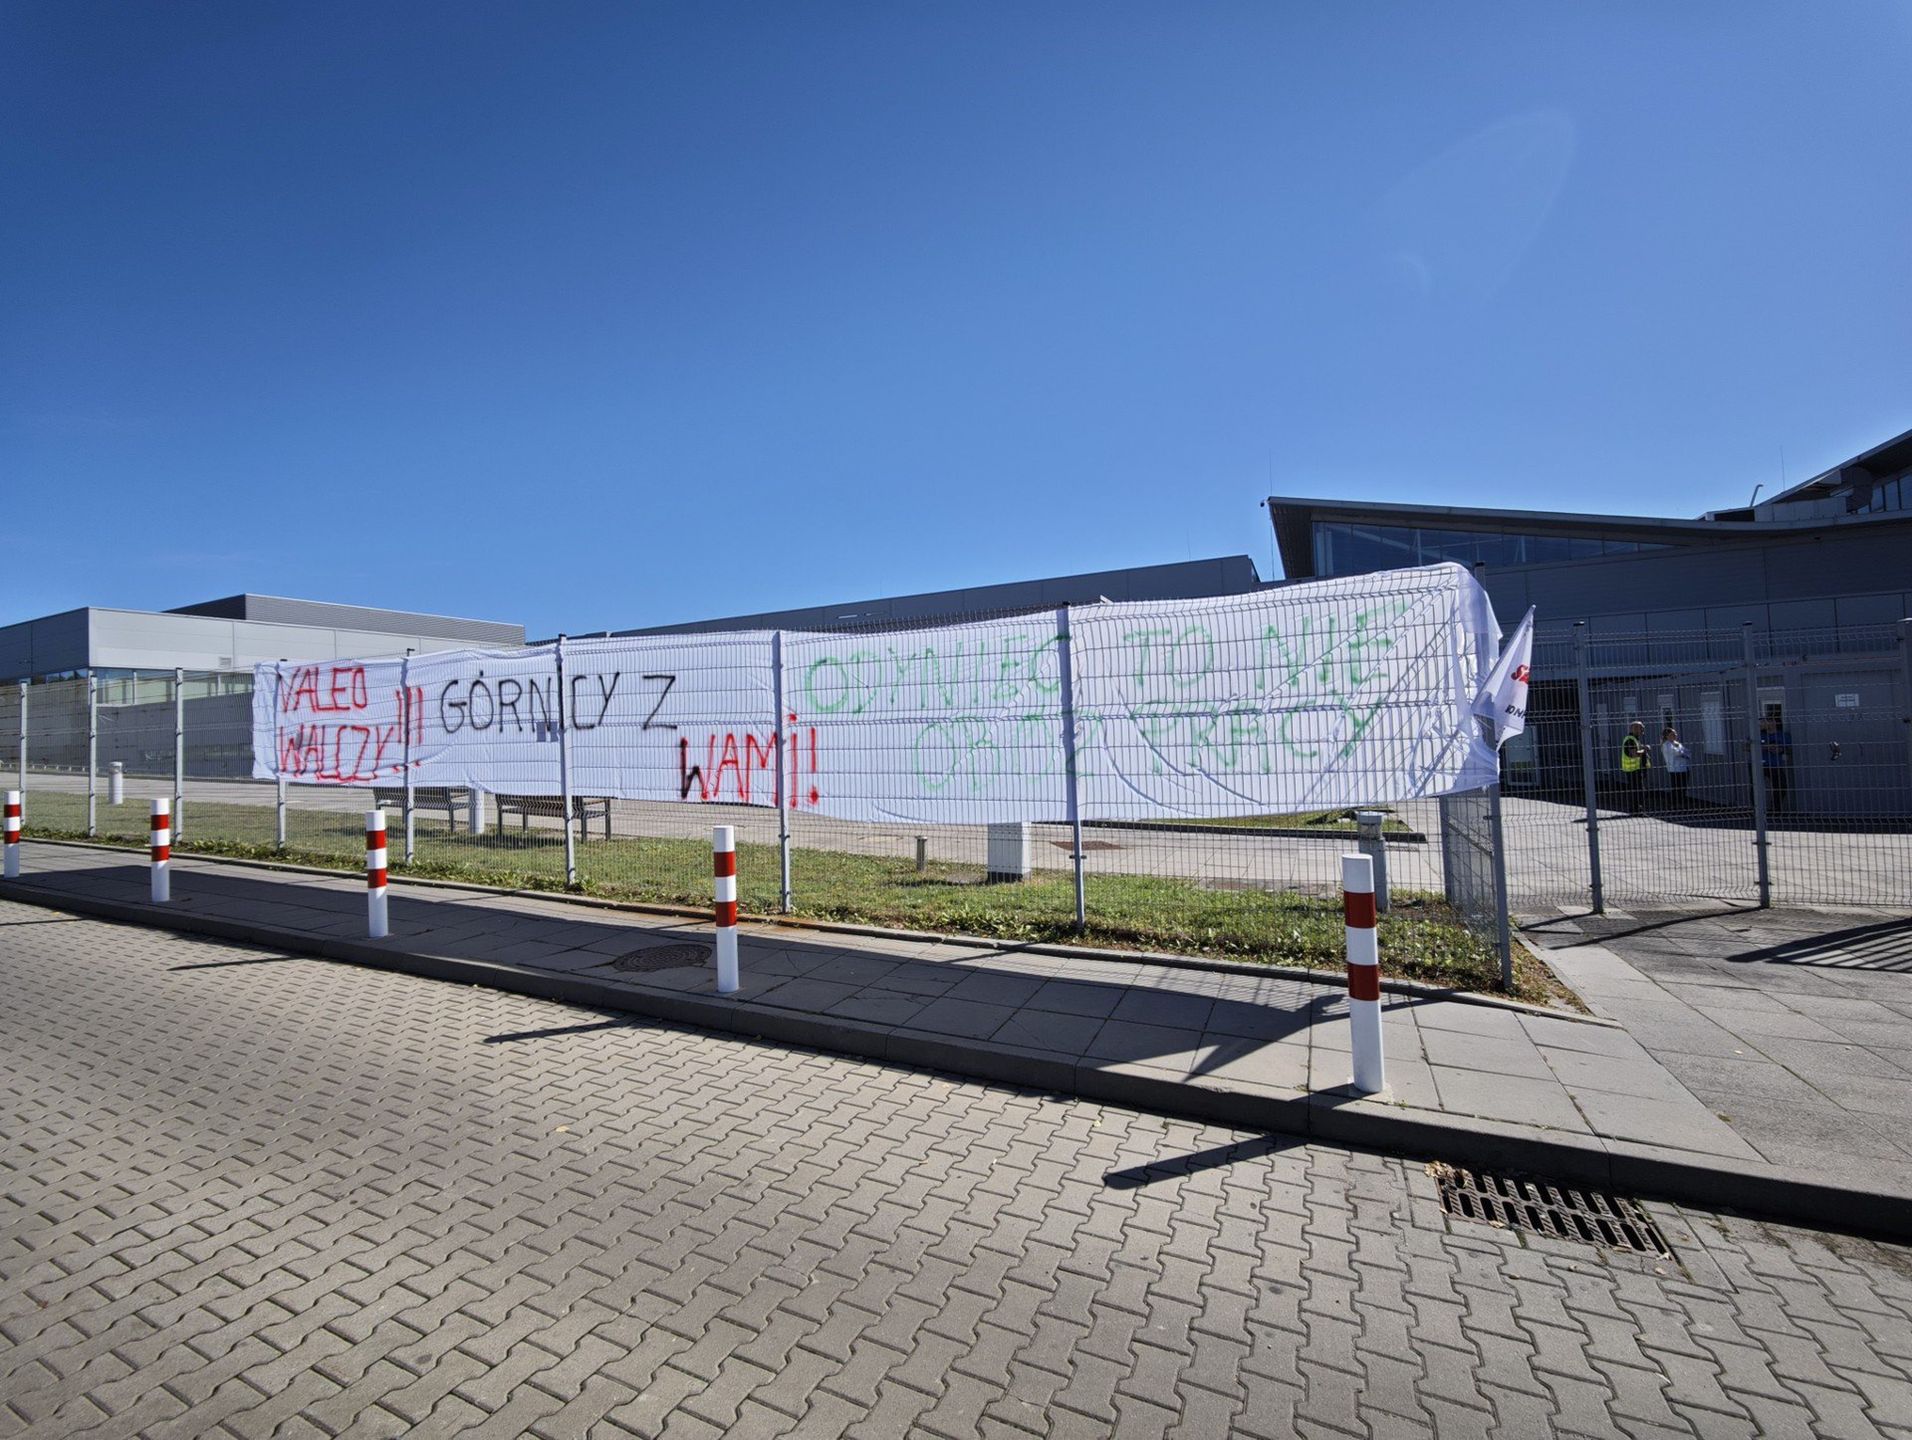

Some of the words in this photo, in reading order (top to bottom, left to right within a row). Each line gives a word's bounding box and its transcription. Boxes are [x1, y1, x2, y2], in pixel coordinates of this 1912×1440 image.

[1122, 623, 1214, 689] TO
[1256, 600, 1408, 690] NIE
[277, 666, 369, 713] VALEO
[441, 669, 620, 734] GÓRNICY
[642, 675, 678, 730] Z
[1128, 690, 1382, 775] PRACY
